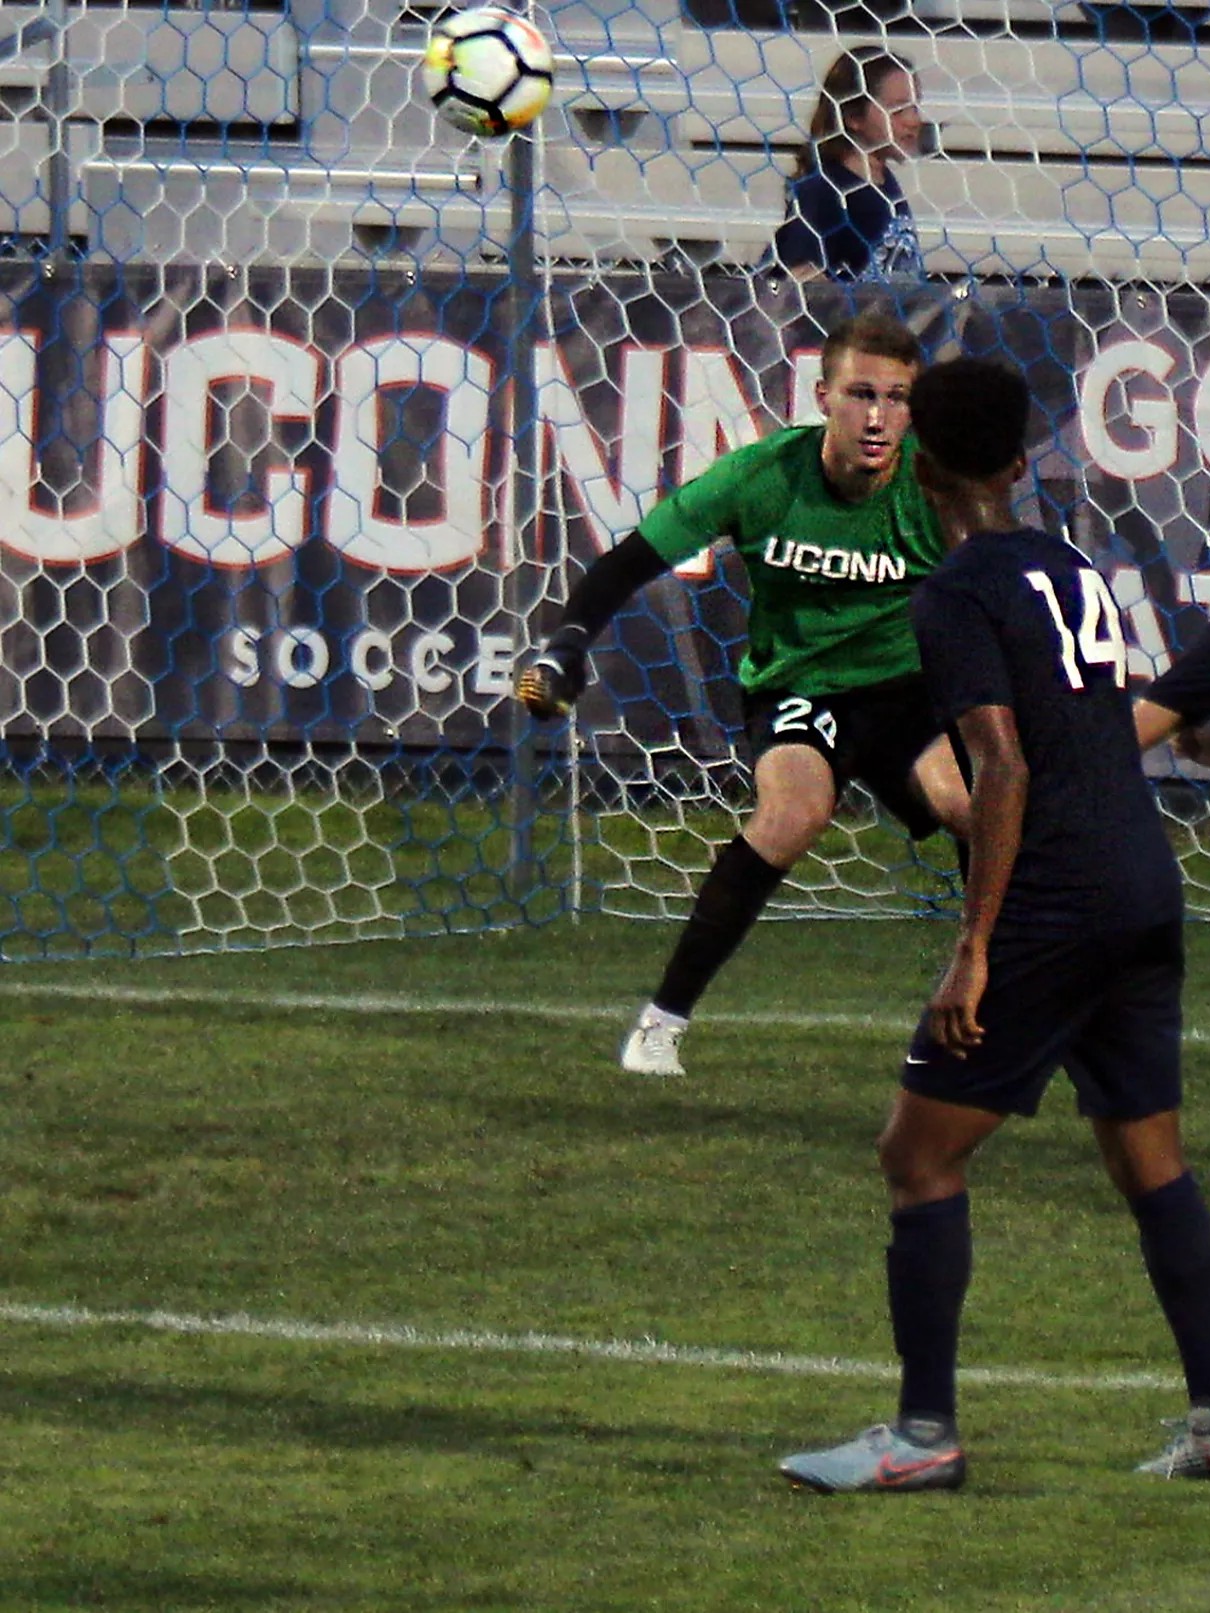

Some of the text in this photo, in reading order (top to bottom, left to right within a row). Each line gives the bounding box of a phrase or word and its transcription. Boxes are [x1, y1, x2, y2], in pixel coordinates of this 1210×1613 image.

[763, 535, 907, 584] UCONN
[226, 627, 552, 697] SOCCE
[1023, 567, 1127, 690] 14
